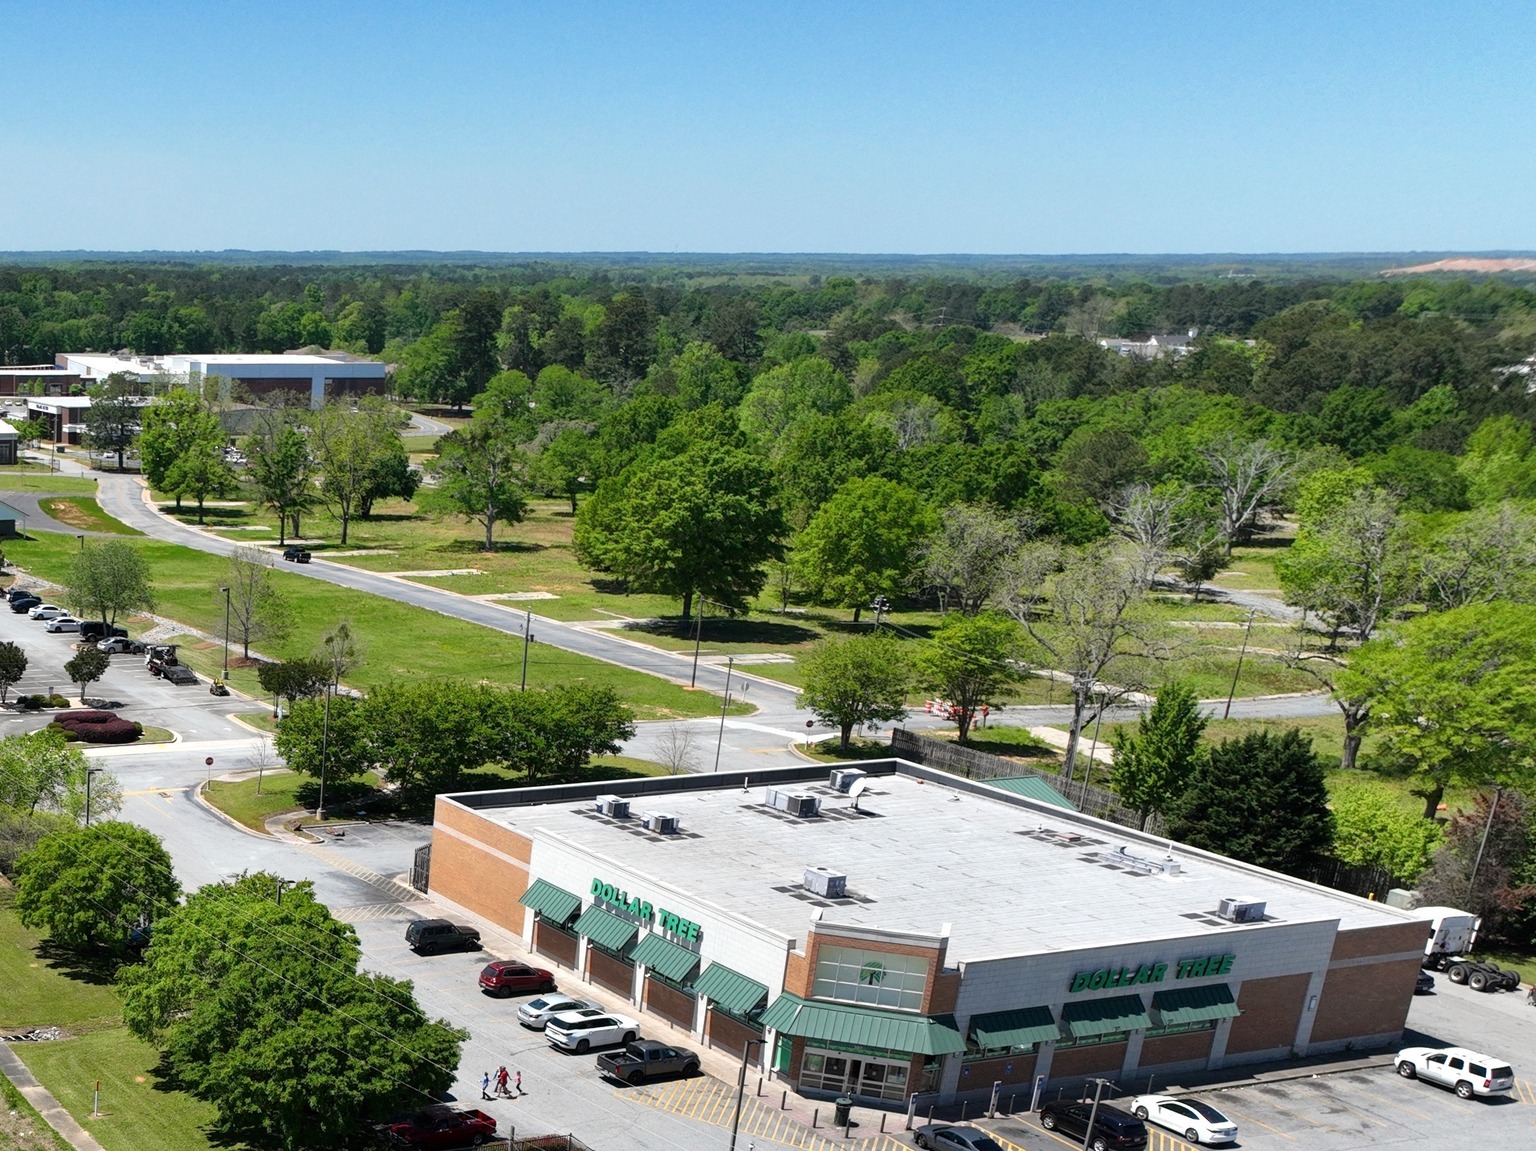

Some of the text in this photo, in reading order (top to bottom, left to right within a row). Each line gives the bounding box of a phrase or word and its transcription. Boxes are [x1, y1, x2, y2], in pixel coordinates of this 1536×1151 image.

[590, 877, 702, 943] DOLLAR TREE
[1069, 954, 1236, 993] DOLLAR TREE
